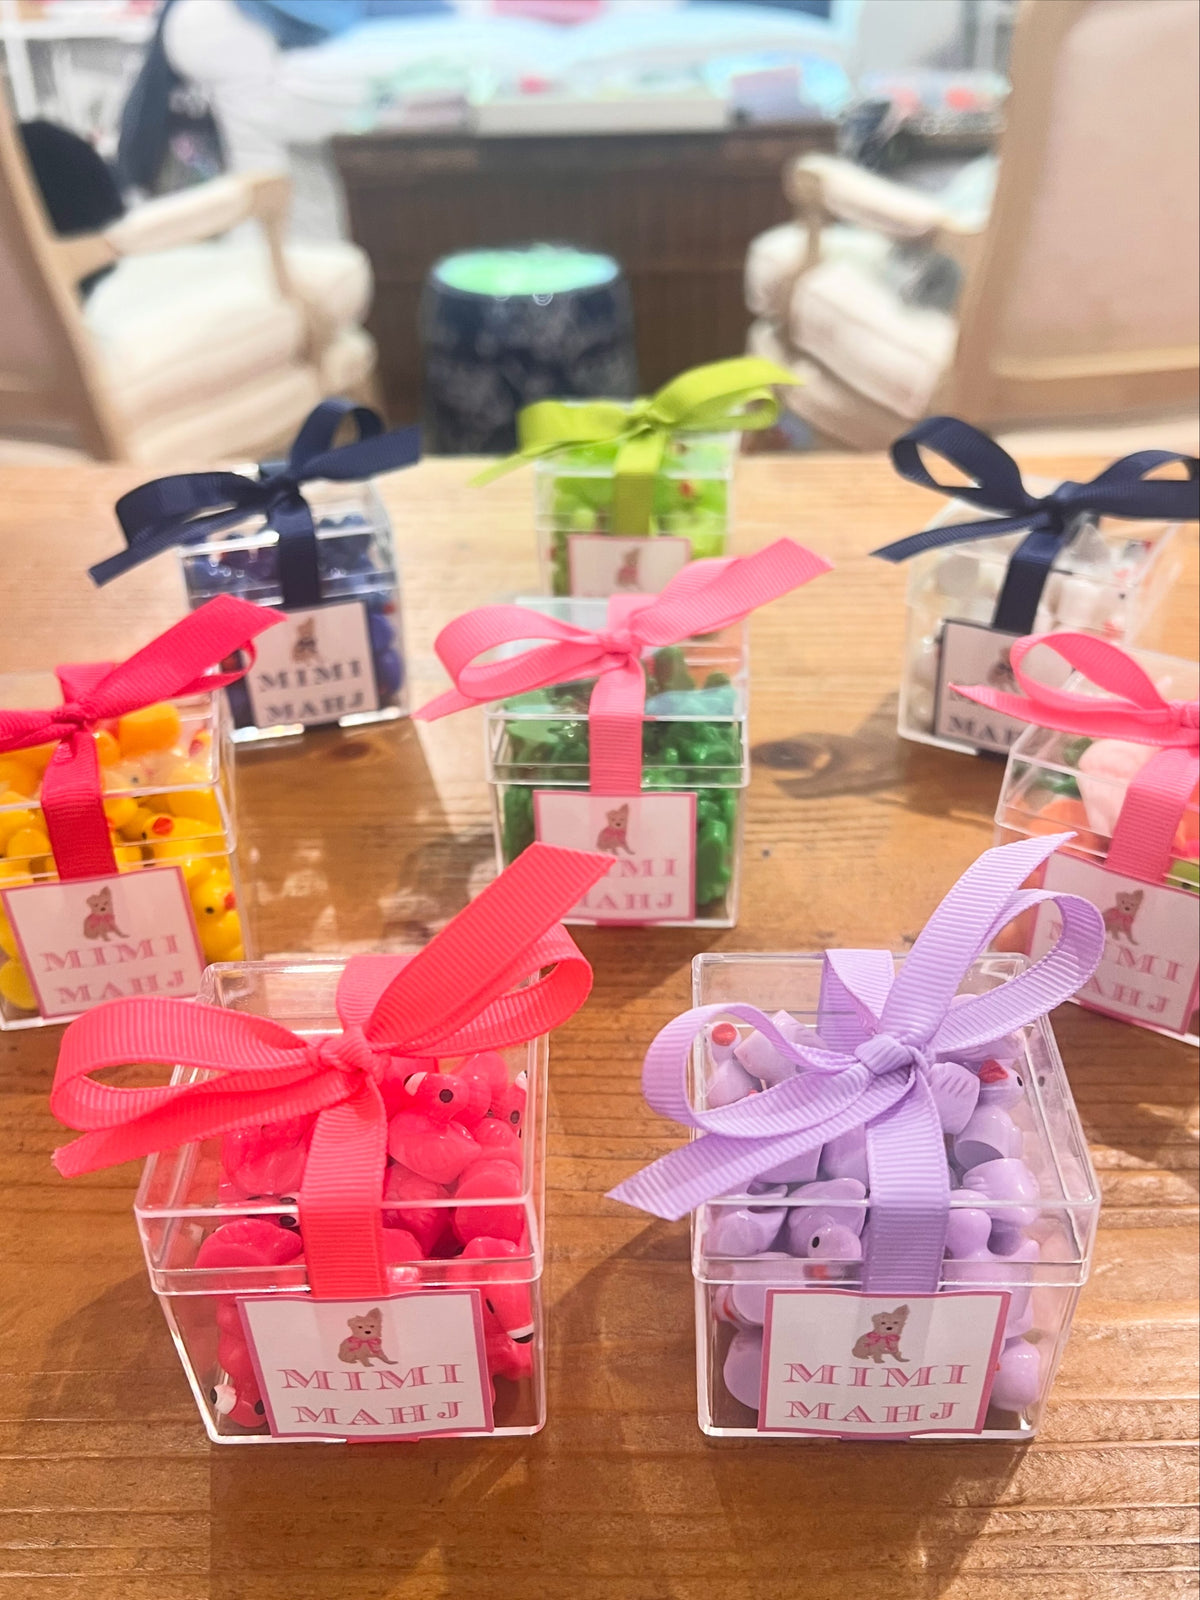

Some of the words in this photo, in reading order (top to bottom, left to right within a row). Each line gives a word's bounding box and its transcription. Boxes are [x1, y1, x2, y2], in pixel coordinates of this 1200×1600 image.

[259, 660, 361, 691] MIMI
[266, 692, 364, 721] MAHJ
[578, 892, 674, 911] AHJ
[40, 934, 181, 973] MIMI
[54, 970, 185, 1004] MAHJ
[277, 1364, 464, 1391] MIMI
[783, 1363, 971, 1388] MIMI
[291, 1401, 463, 1426] MAHJ
[785, 1401, 961, 1424] MAHJ
